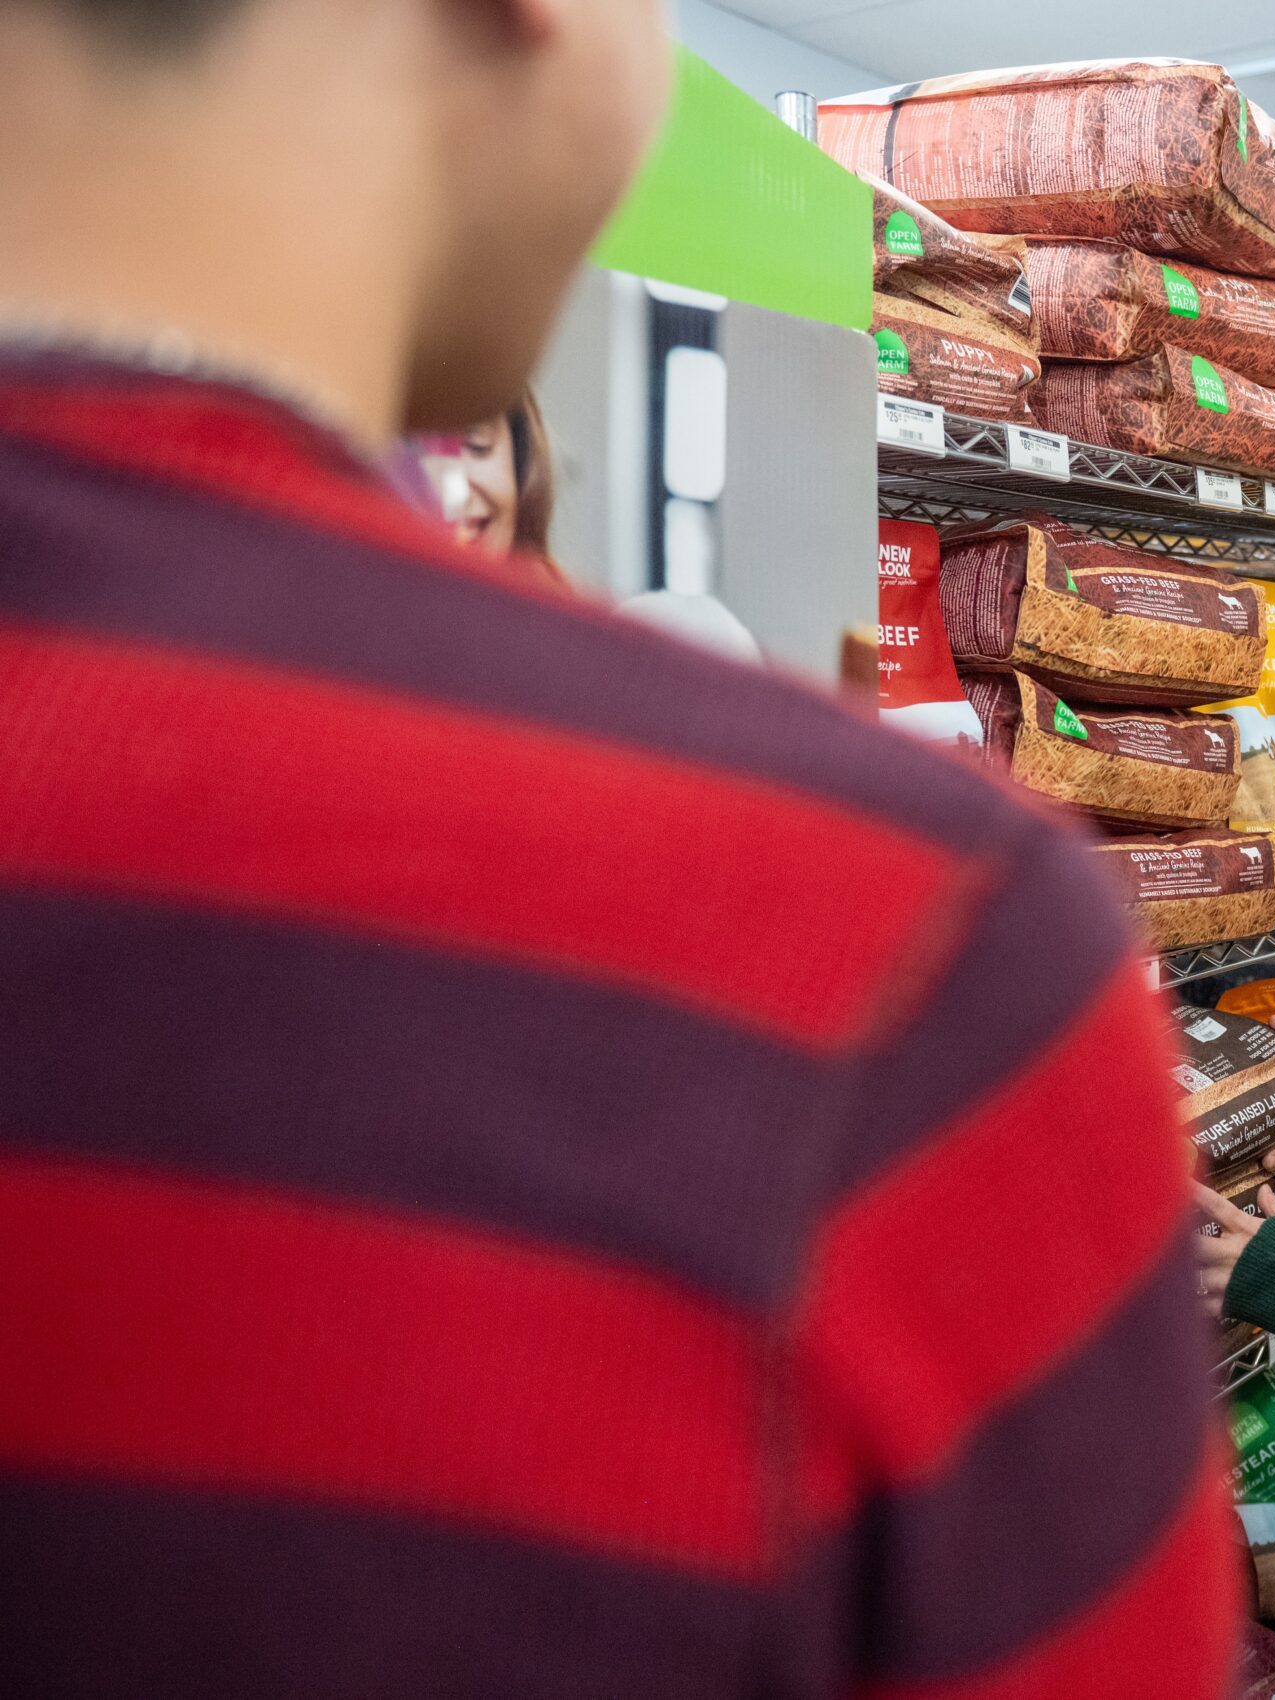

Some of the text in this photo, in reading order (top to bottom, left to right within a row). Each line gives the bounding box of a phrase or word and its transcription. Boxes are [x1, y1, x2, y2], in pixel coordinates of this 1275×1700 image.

[889, 230, 918, 241] OPEN
[890, 241, 920, 251] FARM
[1168, 281, 1195, 297] OPEN
[1171, 296, 1197, 312] FARM
[941, 339, 995, 364] PUPPY
[878, 359, 905, 369] ARM
[1195, 375, 1223, 393] OPEN
[1199, 391, 1226, 407] FARM
[879, 544, 911, 563] NEW
[878, 561, 911, 577] LOOK
[1100, 576, 1180, 590] GRASS-FED BEEF
[1112, 584, 1121, 593] &
[1122, 584, 1144, 593] Ancient
[877, 625, 920, 646] BEEF
[878, 658, 903, 680] ecipe
[1056, 718, 1086, 734] FARM
[1131, 848, 1202, 862] GRASS-FED BEEF
[1140, 858, 1204, 873] & Ancient Grains Recipe
[1190, 1101, 1266, 1146] ASTURE-RAISED
[1210, 1143, 1219, 1158] &
[1219, 1130, 1244, 1156] Ancient
[1244, 1124, 1265, 1141] Grains
[1230, 1411, 1258, 1437] OPEN
[1236, 1420, 1265, 1446] FARM
